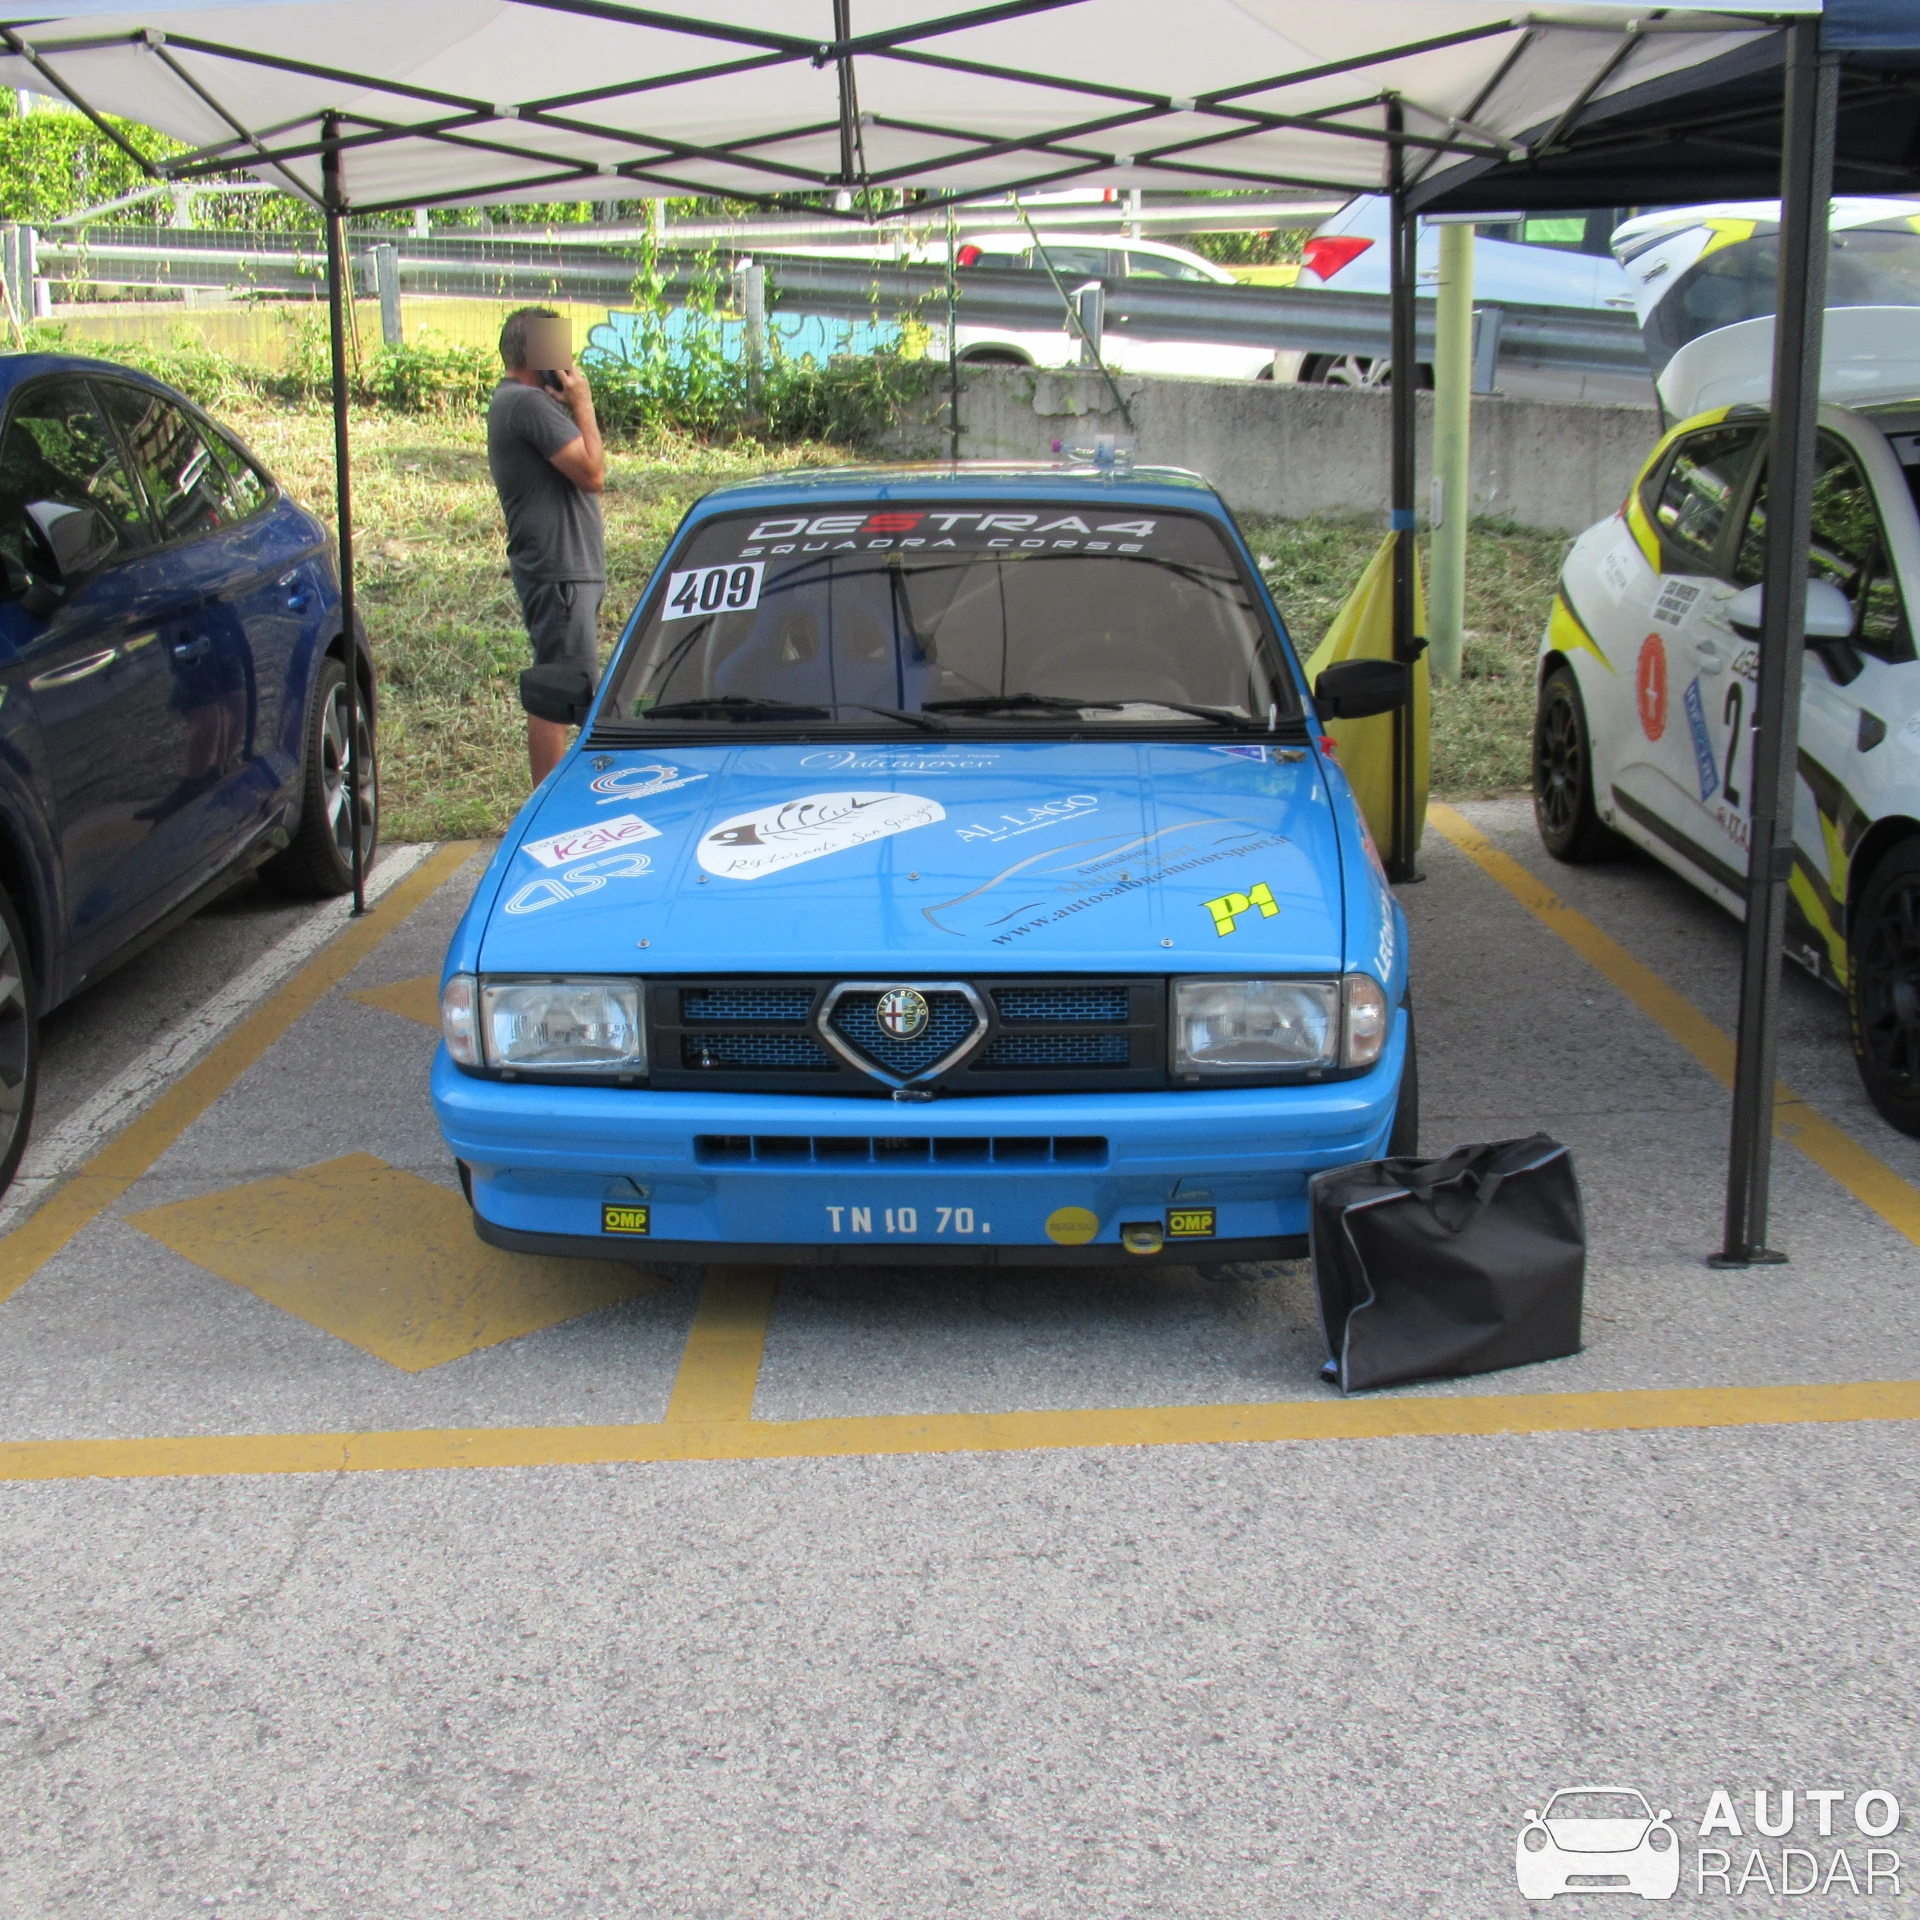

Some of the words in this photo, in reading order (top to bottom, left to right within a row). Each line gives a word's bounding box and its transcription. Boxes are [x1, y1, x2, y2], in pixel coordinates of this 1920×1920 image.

[748, 513, 1156, 541] DESTRA4
[739, 538, 957, 558] SQUADRA
[987, 538, 1144, 553] CORSE
[671, 566, 755, 614] 409
[956, 824, 1008, 842] AL
[1000, 794, 1098, 826] LAGO
[527, 829, 584, 852] Estetica
[724, 842, 840, 874] Ristorante
[851, 827, 882, 843] San
[884, 804, 934, 829] Giorgio
[1077, 847, 1152, 877] Autosalone
[1132, 842, 1200, 870] Sport
[990, 834, 1292, 945] www.autosalonemotorsport.it
[1198, 881, 1280, 938] P1
[879, 993, 896, 1016] ALFA
[900, 990, 927, 1016] ROMEO
[605, 1211, 646, 1228] OMP
[826, 1207, 872, 1233] TN
[1170, 1215, 1212, 1230] OMP
